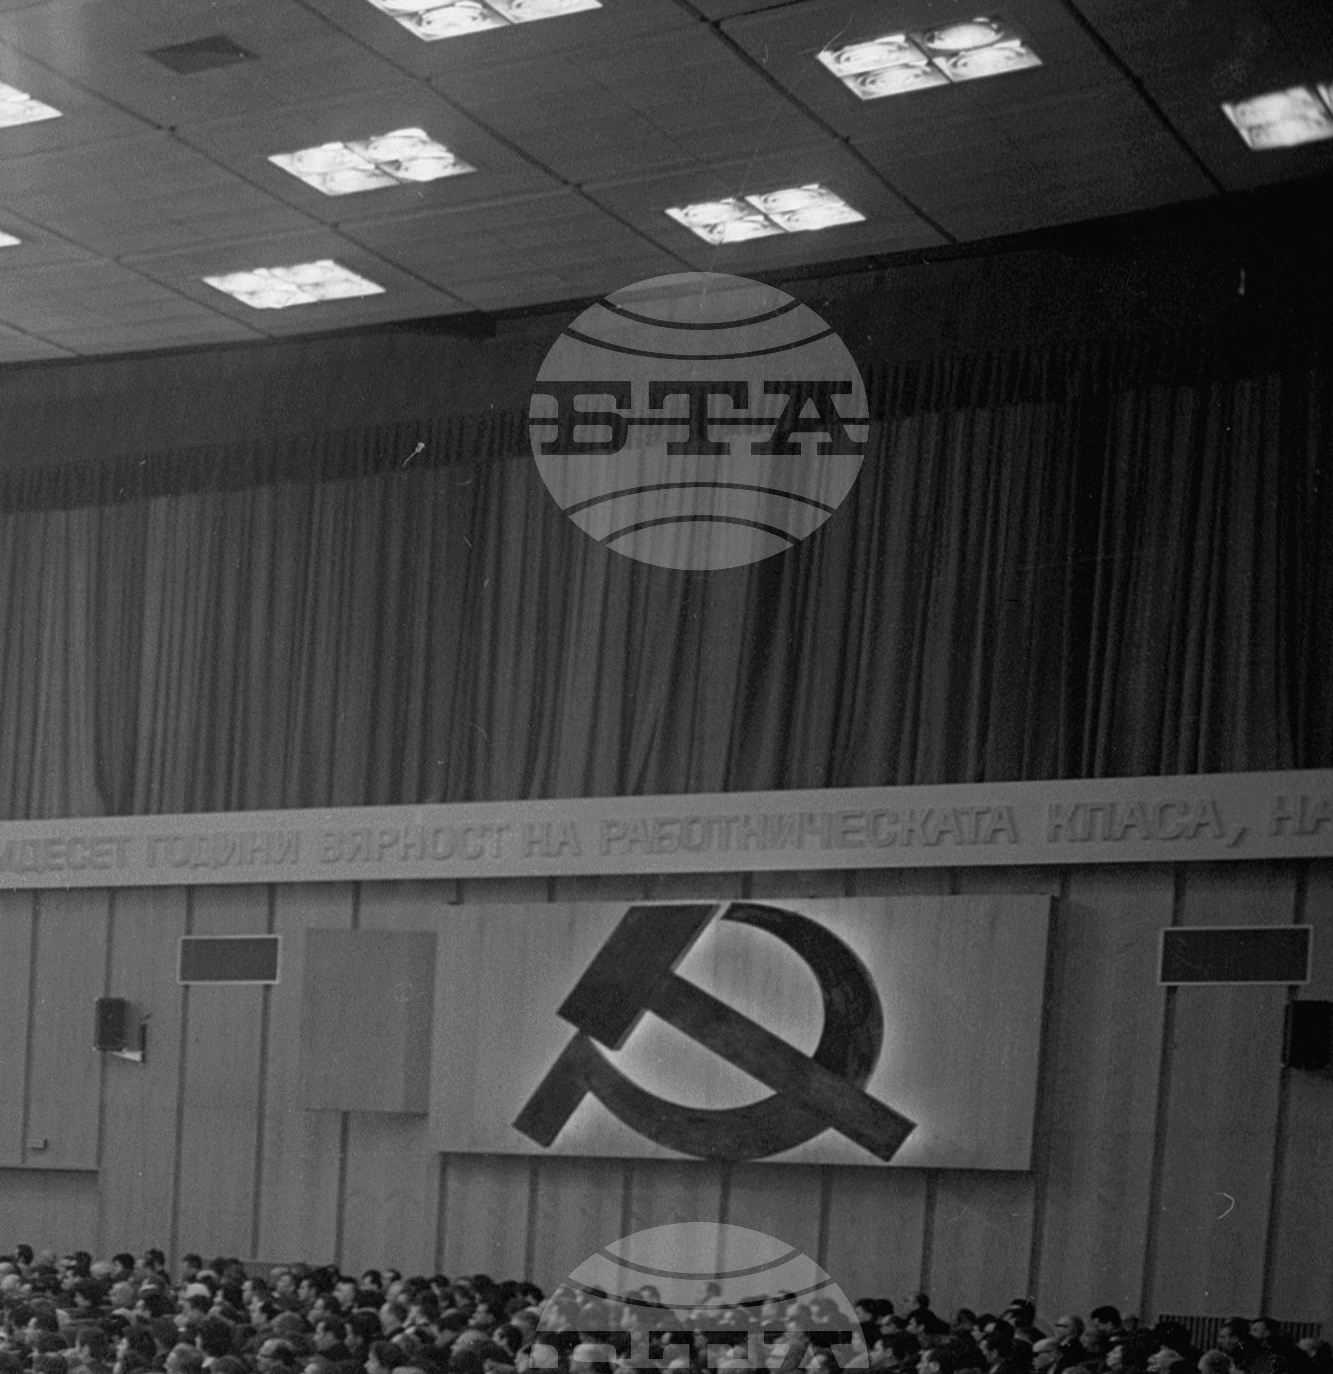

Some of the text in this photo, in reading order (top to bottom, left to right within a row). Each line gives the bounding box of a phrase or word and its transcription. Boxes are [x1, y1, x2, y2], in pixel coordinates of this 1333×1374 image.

[145, 827, 302, 870] ГОДИНИ
[320, 823, 511, 864] ВЯРНОСТ
[522, 819, 582, 858] НА
[598, 805, 1021, 857] РАБОТНИЧЕСКАТА
